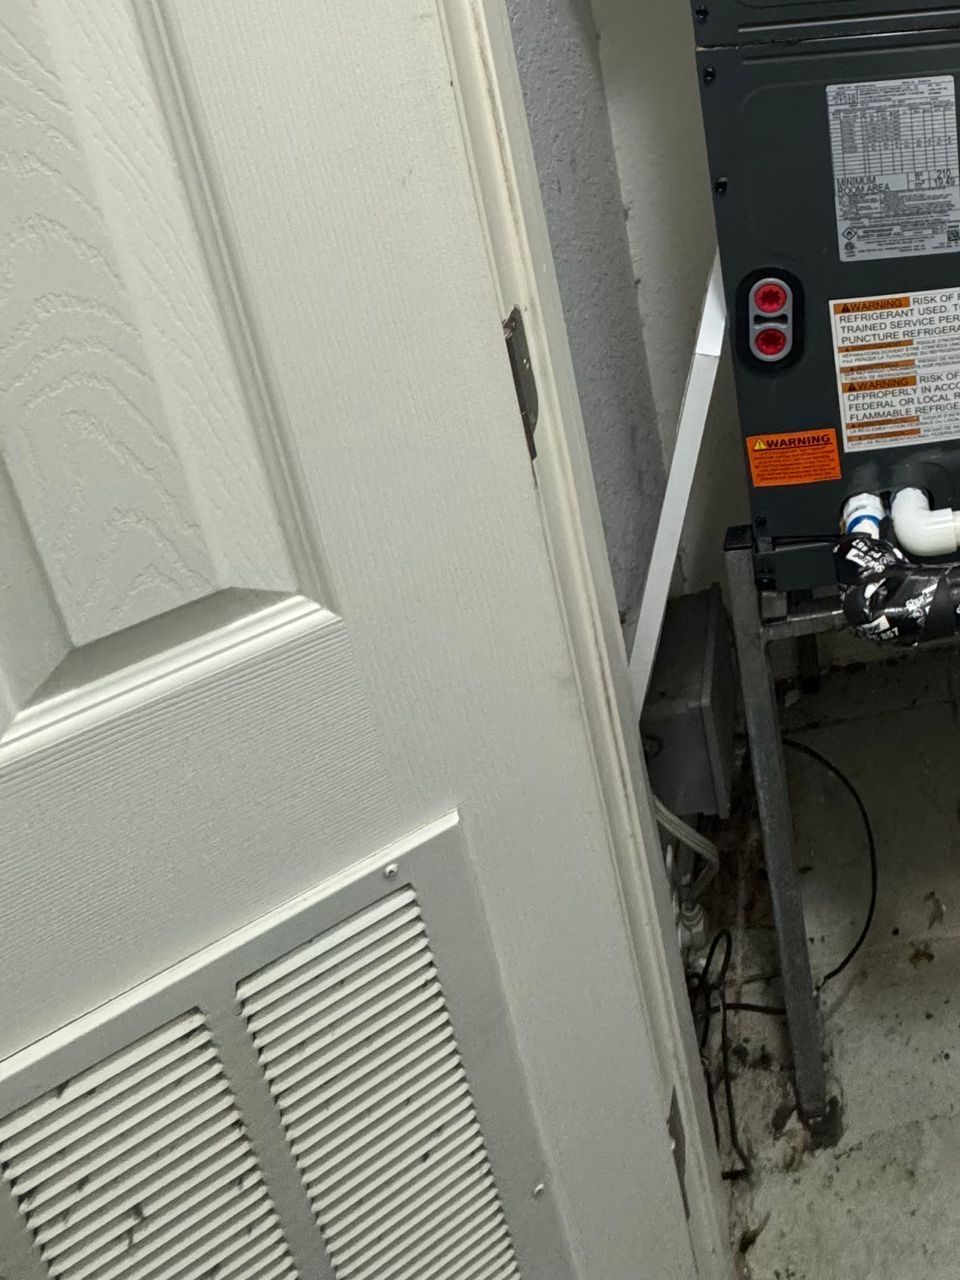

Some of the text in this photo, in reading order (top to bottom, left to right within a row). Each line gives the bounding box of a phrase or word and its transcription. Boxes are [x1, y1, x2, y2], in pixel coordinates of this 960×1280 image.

[867, 183, 890, 193] AREA
[851, 298, 902, 312] WARNING
[912, 295, 937, 305] RISK
[939, 293, 954, 302] OF
[839, 308, 914, 325] REFRIGERANT
[840, 321, 886, 335] TRAINED
[889, 316, 935, 329] SERVICE
[841, 330, 900, 346] PUNCTURE
[858, 377, 908, 391] WARNING
[919, 373, 943, 384] RISK
[945, 371, 960, 380] OF
[921, 384, 931, 393] IN
[848, 398, 896, 413] FEDERAL
[898, 397, 914, 407] OR
[916, 392, 950, 404] LOCAL
[849, 406, 912, 423] FLAMMABLE
[767, 434, 830, 448] WARNING
